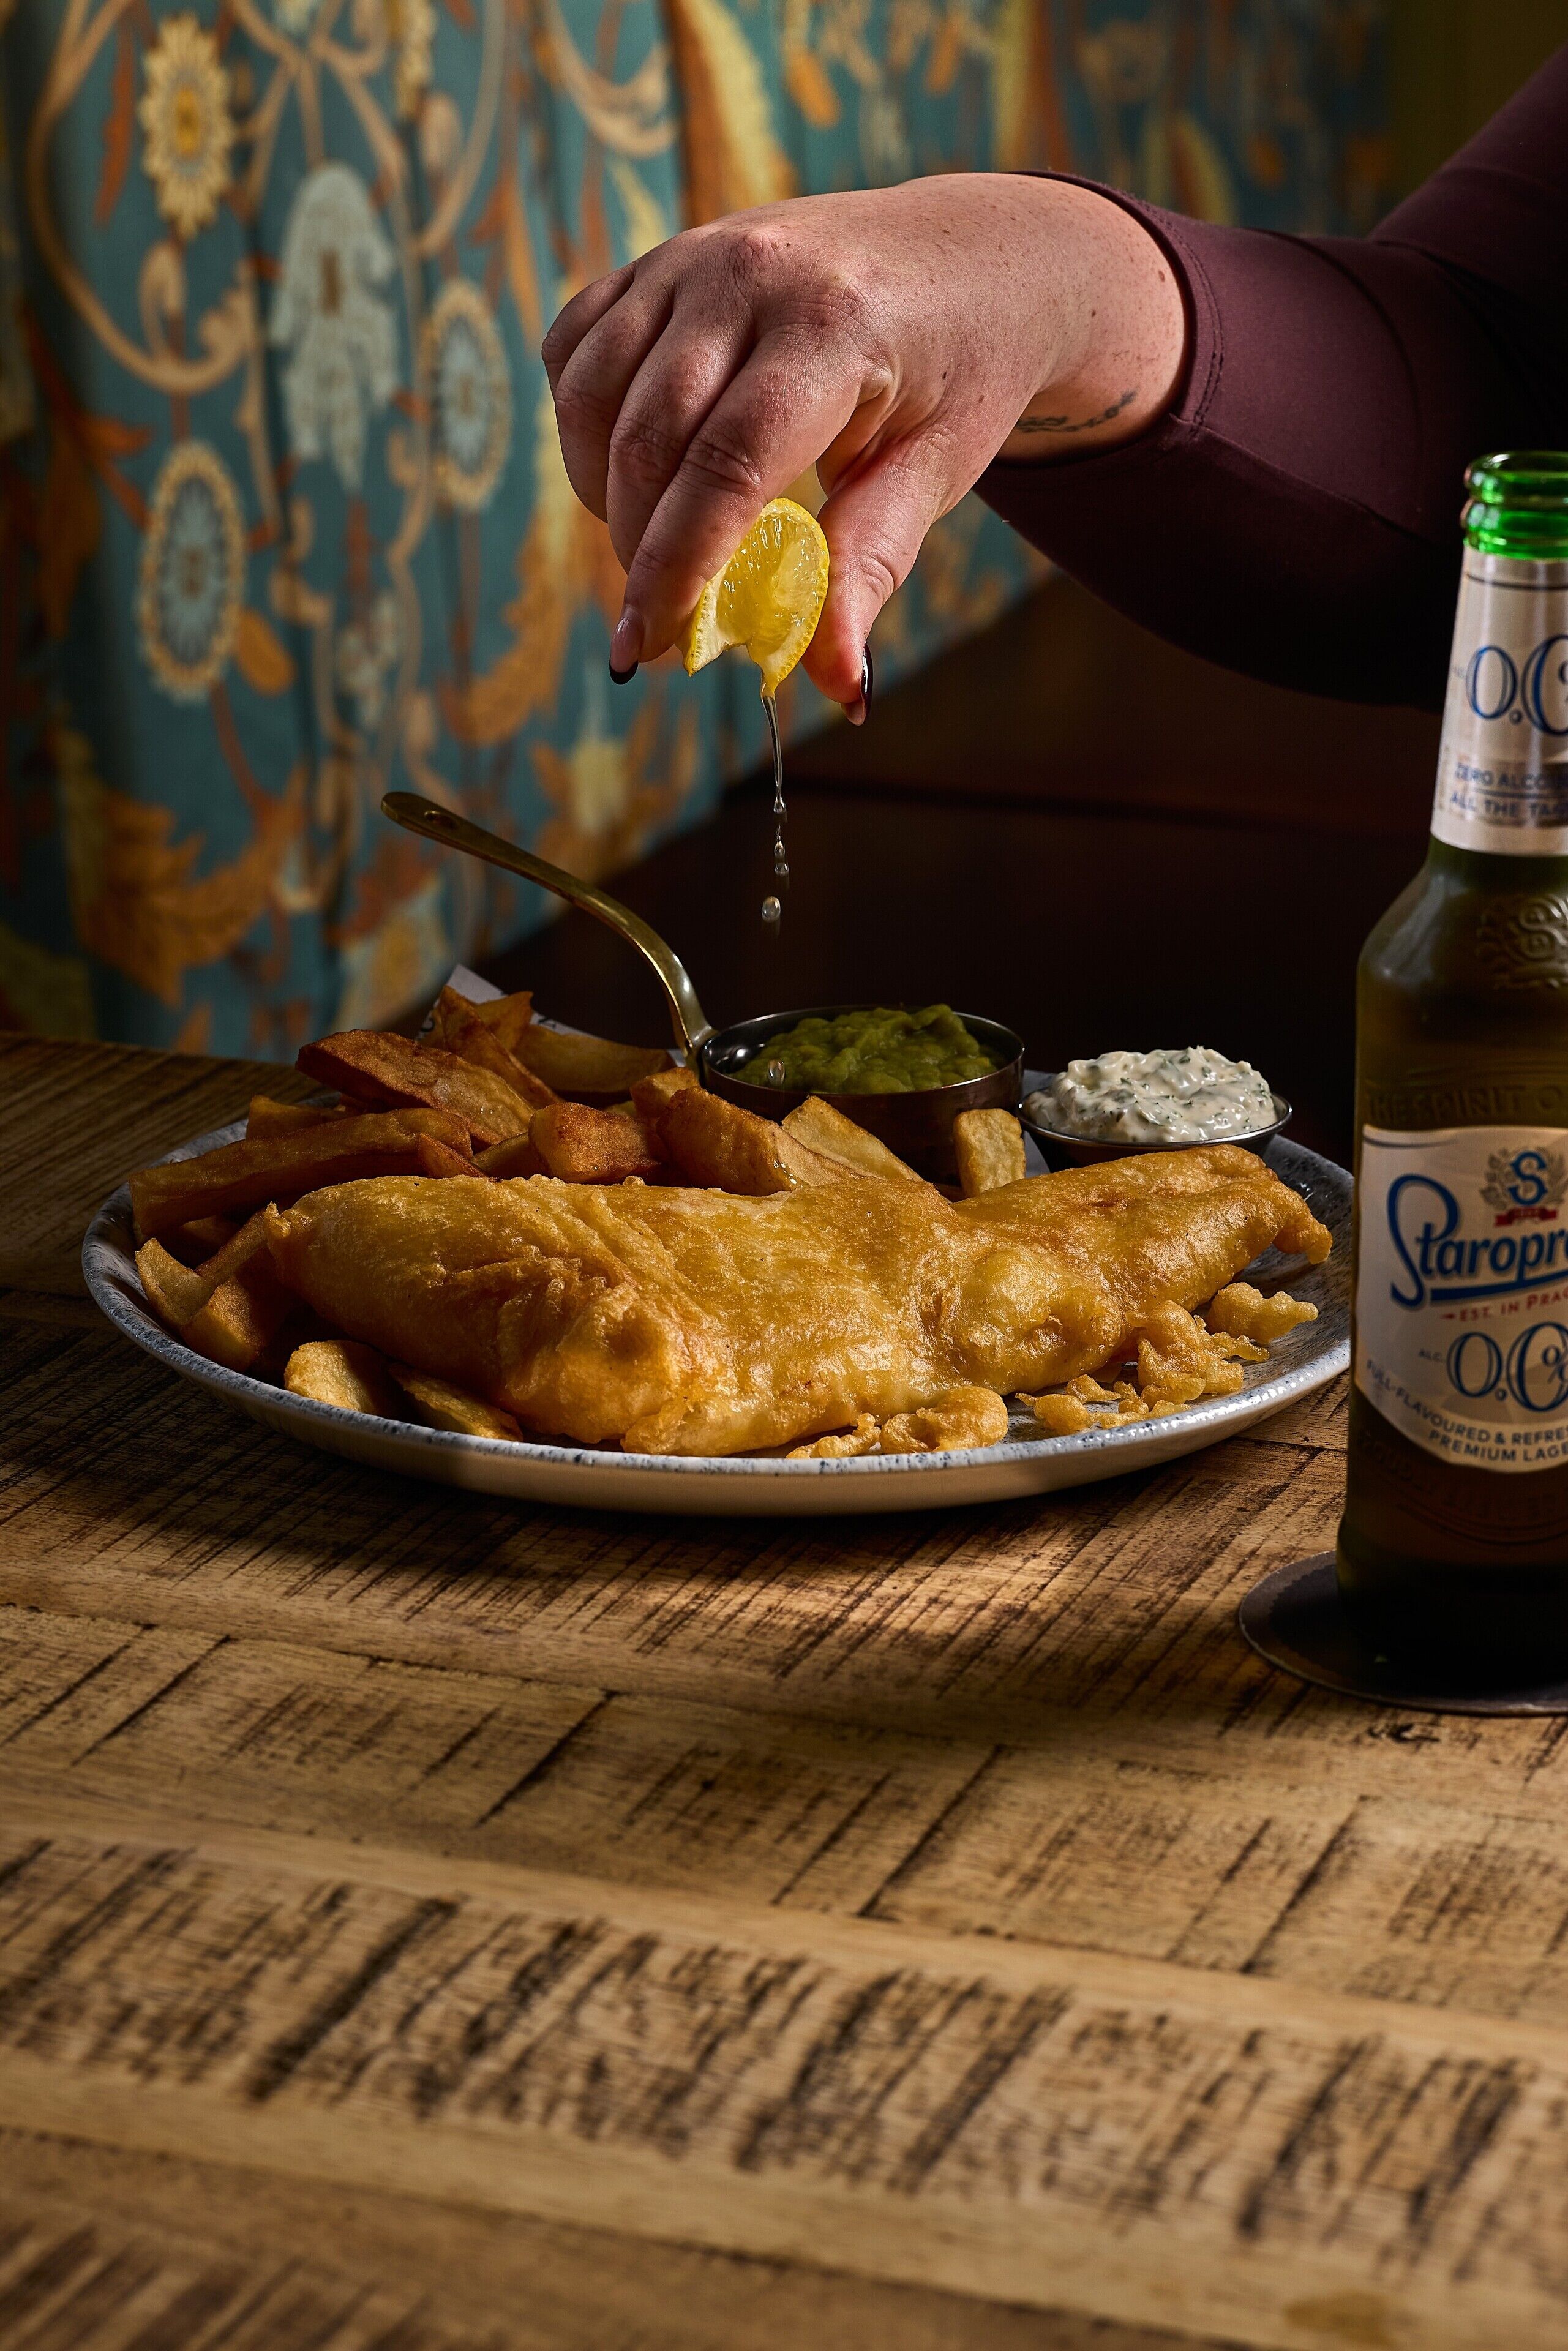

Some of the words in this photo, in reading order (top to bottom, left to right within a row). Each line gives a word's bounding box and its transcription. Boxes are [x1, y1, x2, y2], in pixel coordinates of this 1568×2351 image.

[1455, 762, 1494, 786] ZERO
[1450, 790, 1477, 812] ALL
[1484, 798, 1521, 817] THE
[1411, 1084, 1526, 1122] SPIRIT
[1510, 1152, 1547, 1205] S
[1387, 1174, 1568, 1306] Staropr
[1501, 1301, 1520, 1314] IN
[1366, 1359, 1490, 1443] FULL-FLAVOURED
[1494, 1431, 1506, 1445] &
[1511, 1425, 1568, 1446] REFRE
[1428, 1429, 1517, 1462] PREMIUM
